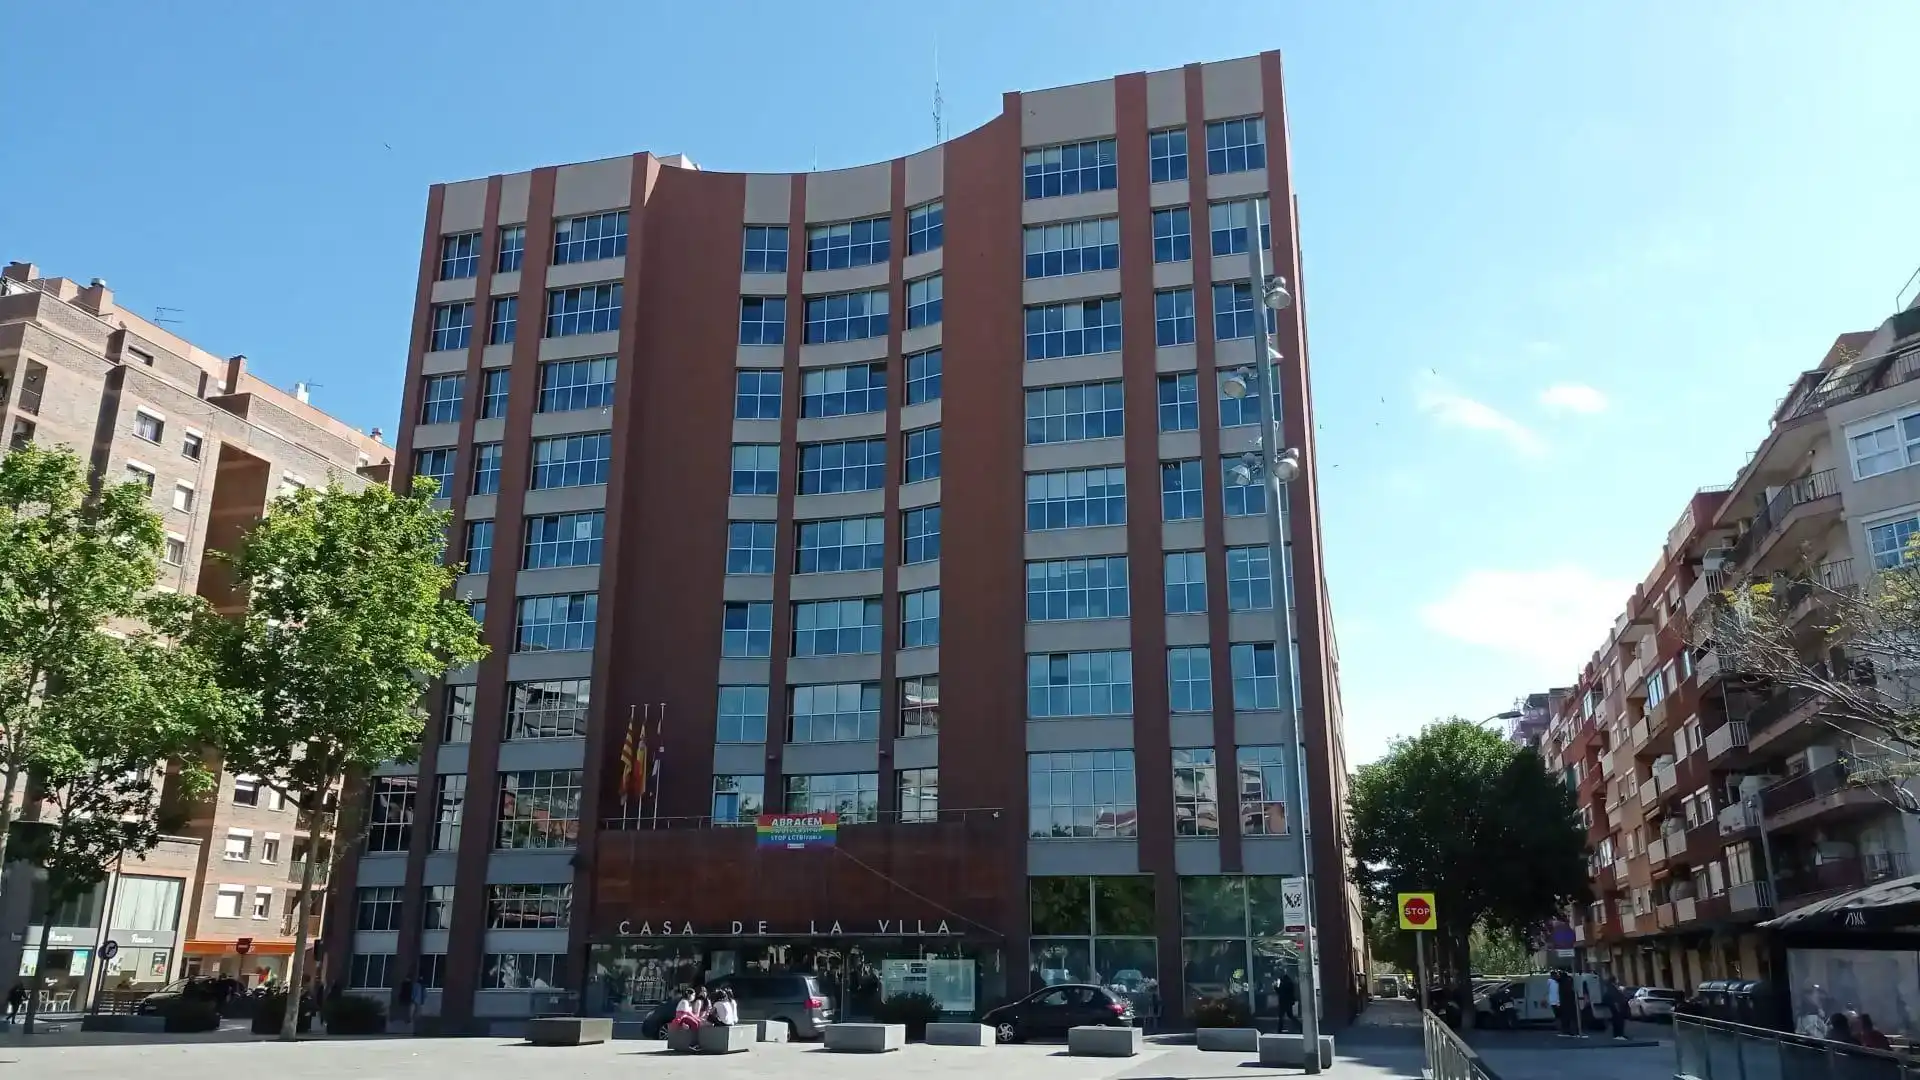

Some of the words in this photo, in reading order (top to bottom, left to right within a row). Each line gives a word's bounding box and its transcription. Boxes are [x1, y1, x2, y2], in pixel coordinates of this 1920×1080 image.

[1405, 907, 1430, 915] STOP
[619, 920, 694, 935] CASA
[732, 920, 768, 935] DE
[810, 920, 843, 935] LA
[878, 919, 950, 935] VILA
